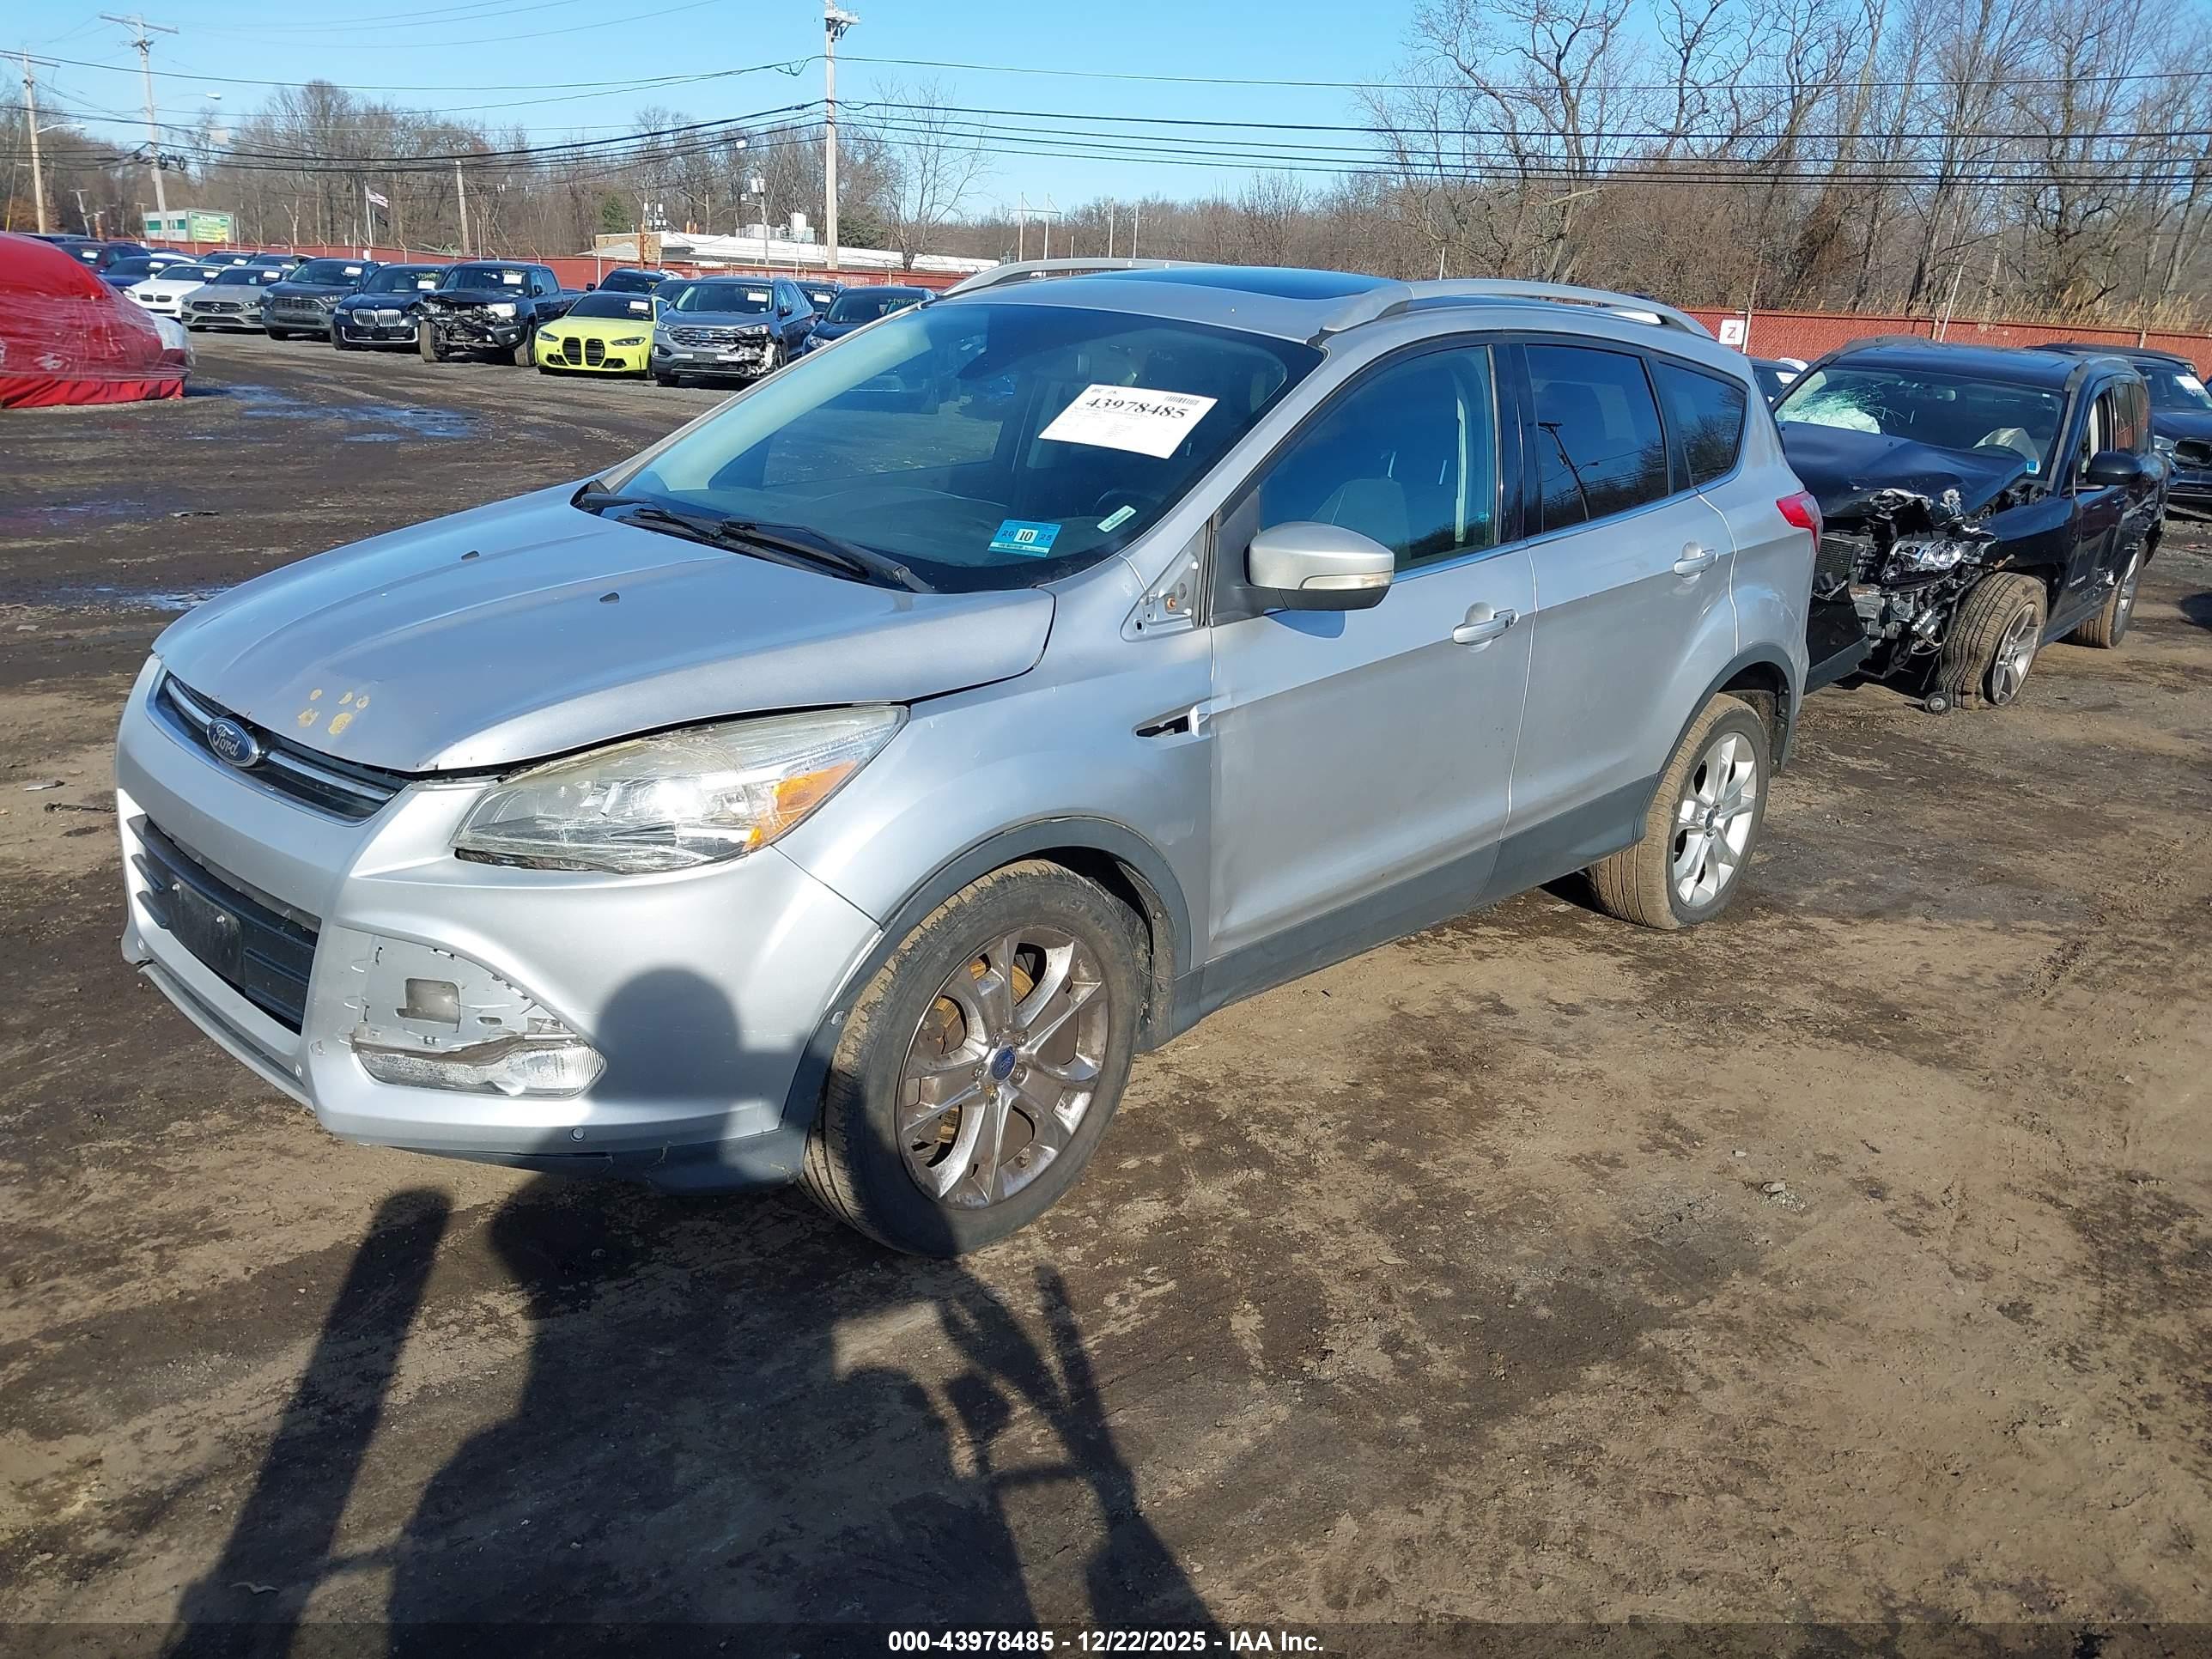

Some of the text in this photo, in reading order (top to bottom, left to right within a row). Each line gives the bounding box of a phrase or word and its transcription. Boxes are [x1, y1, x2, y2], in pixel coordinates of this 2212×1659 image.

[1085, 398, 1189, 419] 43978485
[1018, 531, 1034, 542] 10
[1039, 533, 1052, 542] 25
[213, 725, 240, 757] Ford
